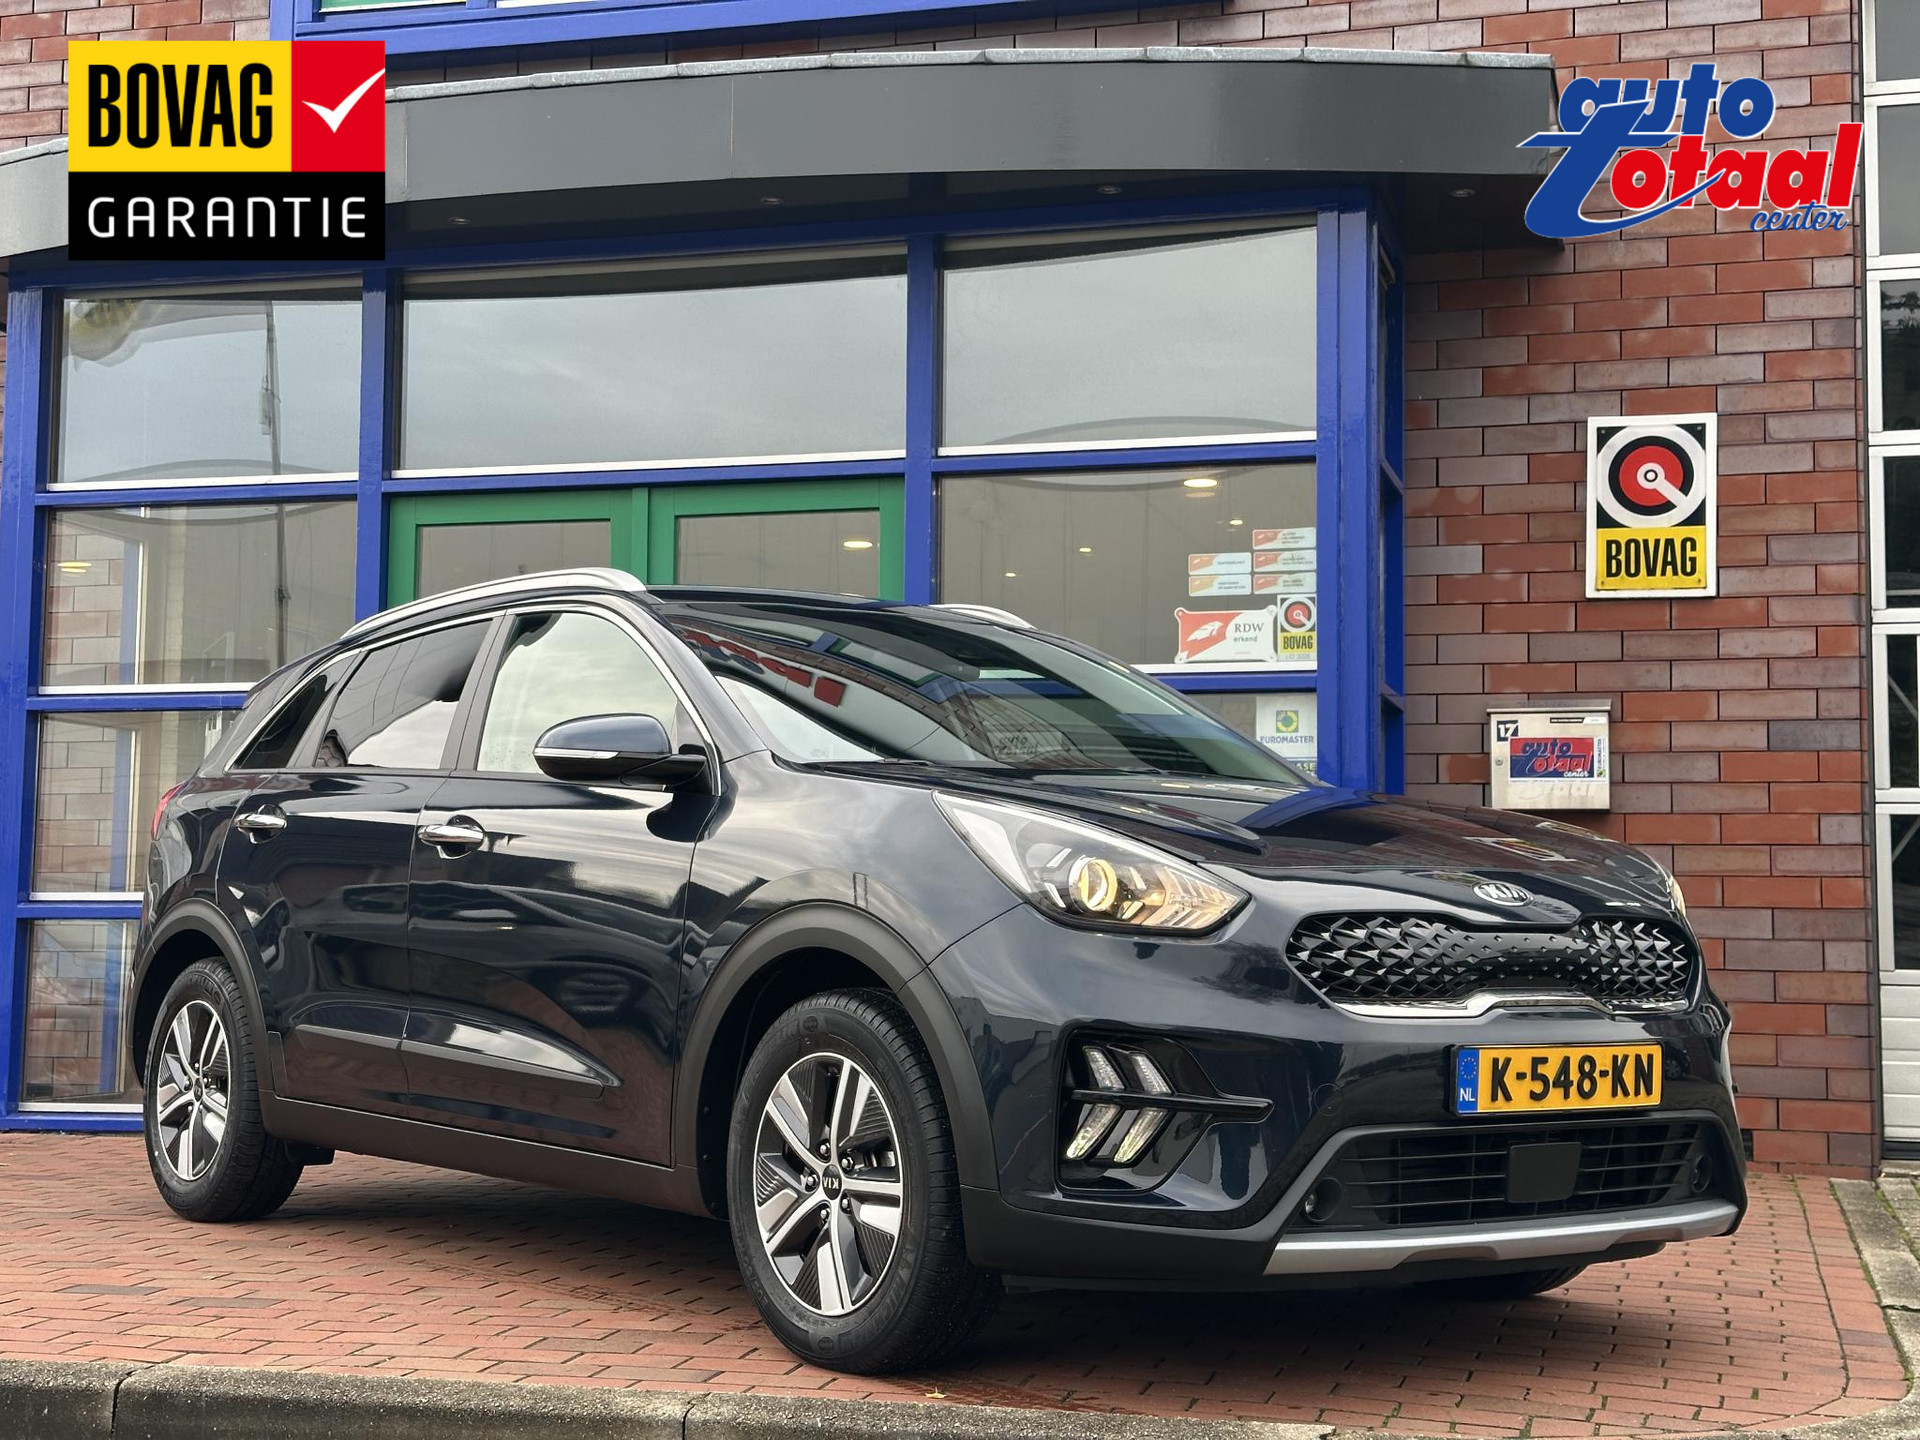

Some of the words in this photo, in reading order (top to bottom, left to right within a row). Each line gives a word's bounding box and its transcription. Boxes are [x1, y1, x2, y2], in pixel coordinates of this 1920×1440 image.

[1606, 537, 1697, 578] BOVAG
[1234, 623, 1264, 633] RDW
[1283, 636, 1313, 650] BOVAG
[1498, 724, 1518, 737] 17
[1261, 736, 1314, 744] EUROMASTER
[1563, 768, 1590, 777] center
[1490, 1054, 1654, 1102] K-548-KN
[1460, 1087, 1475, 1102] NL
[822, 1177, 840, 1189] KIA
